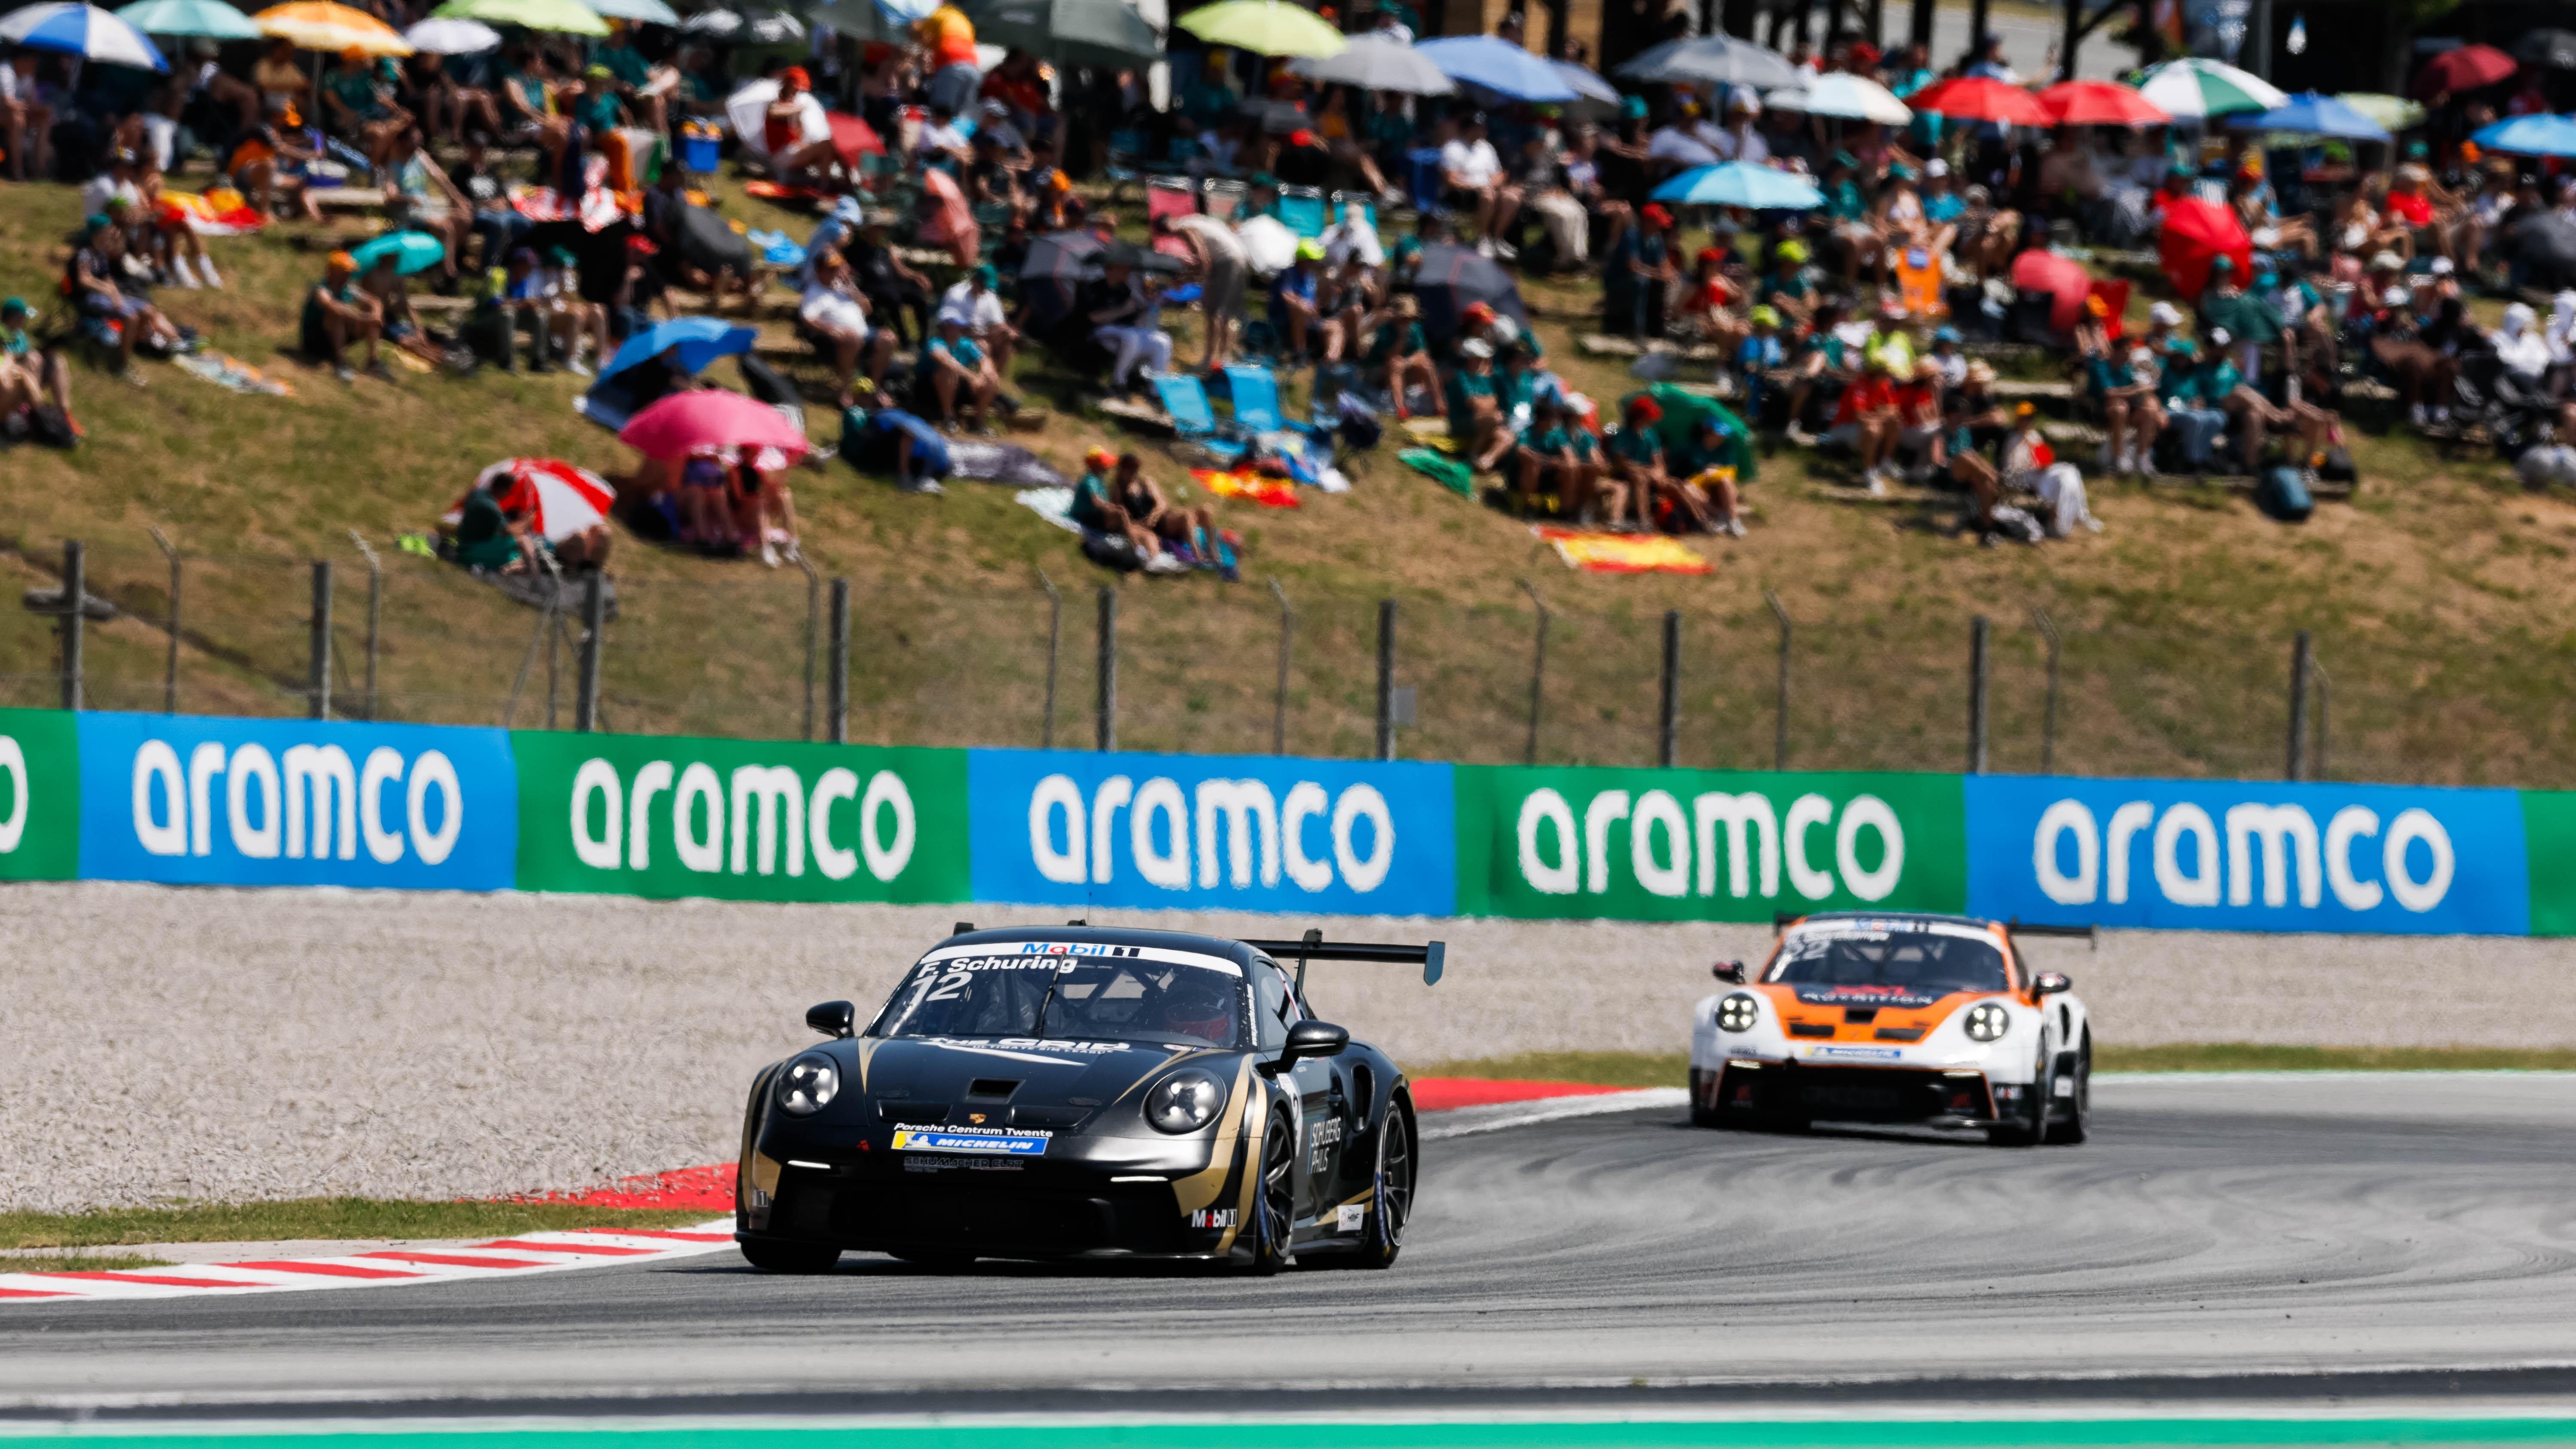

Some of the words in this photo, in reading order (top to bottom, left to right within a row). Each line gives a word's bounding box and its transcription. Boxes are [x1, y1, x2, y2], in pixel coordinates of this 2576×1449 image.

[132, 739, 463, 865] aramco
[570, 758, 916, 882] aramco
[1030, 773, 1395, 894] aramco
[1518, 787, 1905, 901] aramco
[2033, 798, 2456, 913] aramco
[1022, 943, 1106, 955] Mobil
[917, 961, 941, 978] F.
[948, 955, 1078, 973] Schuring
[906, 971, 972, 1011] 12
[894, 1123, 945, 1132] Porsche
[947, 1125, 1002, 1135] Centrum
[1005, 1128, 1053, 1137] Twente
[936, 1138, 1034, 1149] MICHELIN
[1311, 1117, 1341, 1147] SCHUBERG
[904, 1157, 990, 1167] SCHUMACHER
[1192, 1209, 1227, 1228] Mobil
